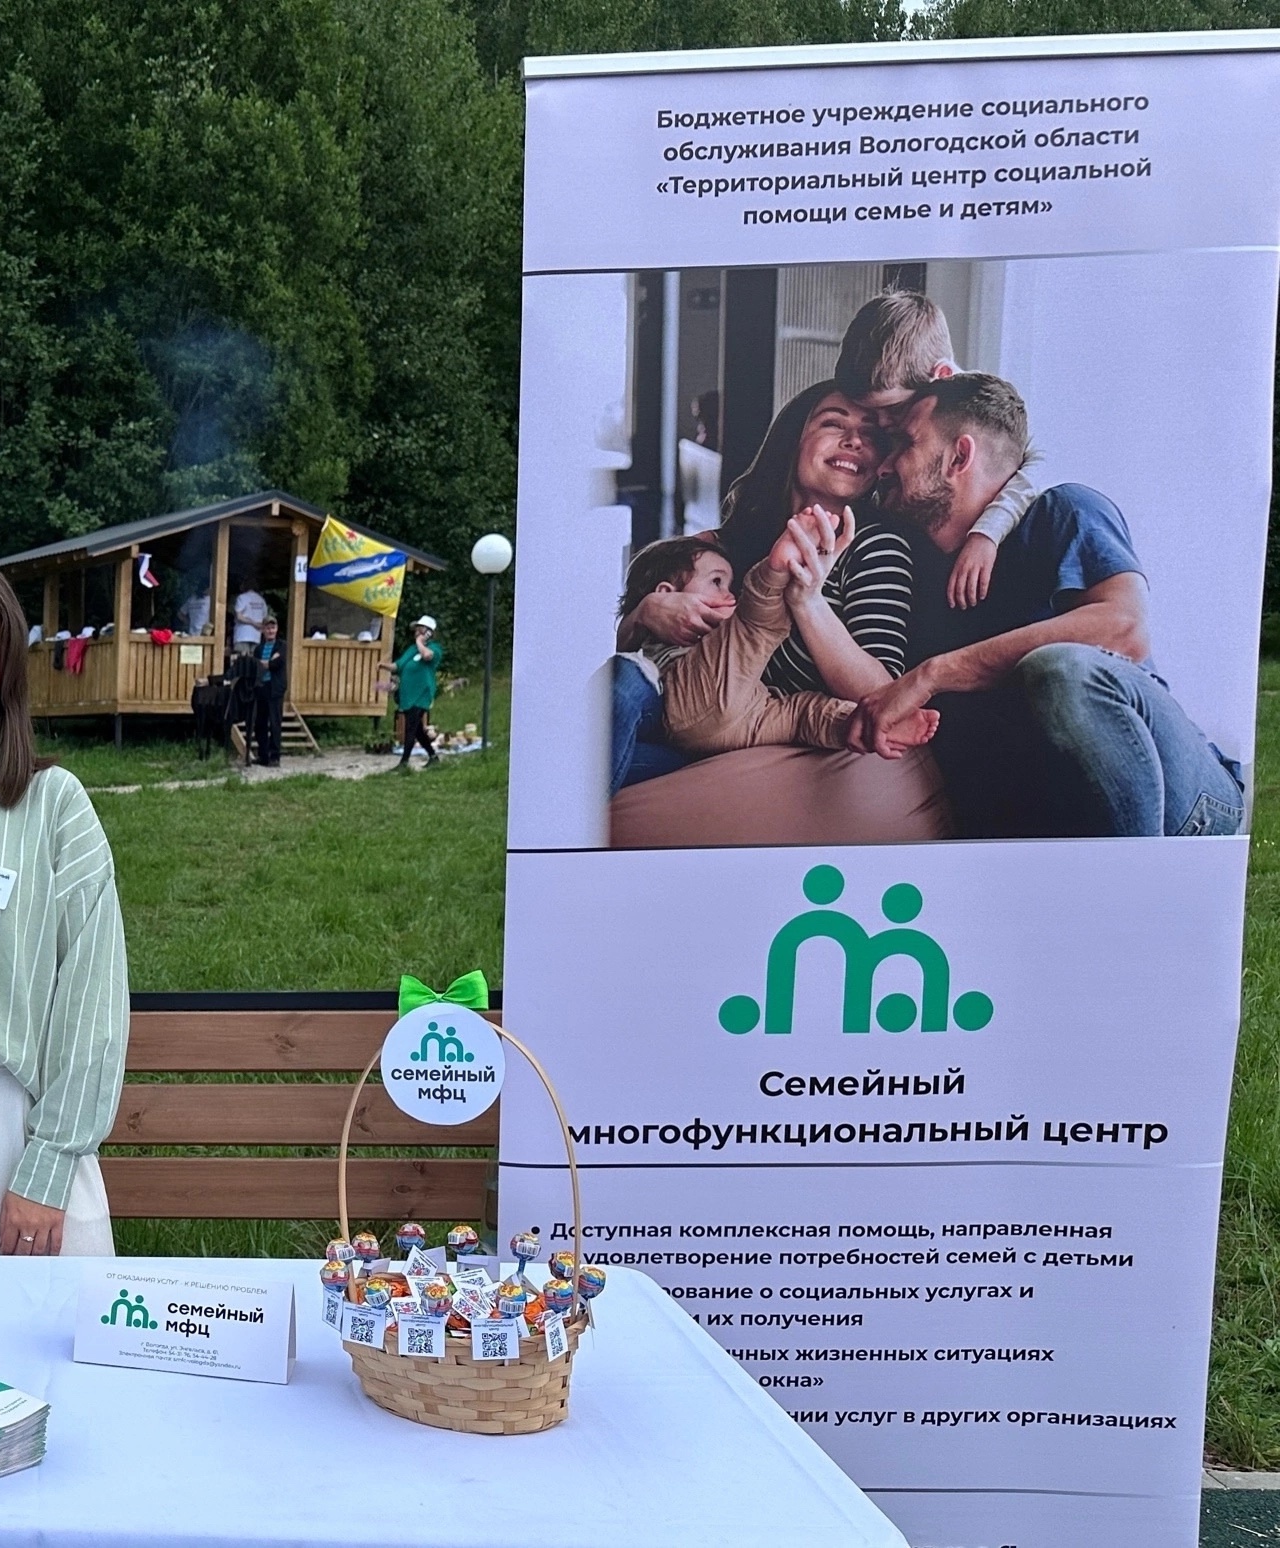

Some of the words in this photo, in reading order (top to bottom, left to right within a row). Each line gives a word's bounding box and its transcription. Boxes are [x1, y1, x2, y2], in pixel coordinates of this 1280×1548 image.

[657, 108, 806, 130] Бюджетное
[812, 103, 974, 128] учреждение
[981, 96, 1149, 118] социального
[663, 141, 851, 164] обслуживания
[859, 128, 1027, 154] Вологодской
[1034, 127, 1139, 148] области
[656, 167, 903, 198] «Территориальный
[911, 169, 987, 189] центр
[994, 157, 1151, 184] социальной
[743, 207, 847, 225] помощи
[854, 203, 932, 221] семье
[940, 204, 954, 219] и
[961, 199, 1053, 220] детям»
[391, 1065, 495, 1083] семейный
[759, 1067, 965, 1097] Семейный
[418, 1084, 467, 1104] мфц
[568, 1114, 1029, 1151] многофункциональный
[1043, 1121, 1169, 1150] центр
[679, 1225, 831, 1238] комплексная
[838, 1224, 935, 1241] помощь,
[941, 1223, 1113, 1240] направленная
[584, 1252, 773, 1268] удовлетворение
[779, 1247, 940, 1269] потребностей
[946, 1247, 1017, 1264] семей
[1024, 1252, 1037, 1264] с
[1042, 1252, 1134, 1267] детьми
[760, 1287, 774, 1299] о
[780, 1286, 919, 1301] социальных
[925, 1286, 1012, 1303] услугах
[1019, 1286, 1034, 1299] и
[167, 1302, 264, 1324] семейный
[707, 1314, 734, 1326] их
[740, 1313, 864, 1330] получения
[165, 1319, 210, 1338] мфц
[794, 1349, 928, 1361] жизненных
[933, 1348, 1055, 1364] ситуациях
[758, 1375, 824, 1388] окна»
[834, 1410, 898, 1427] услуг
[903, 1411, 916, 1423] в
[921, 1411, 1001, 1427] других
[1006, 1411, 1177, 1430] организациях
